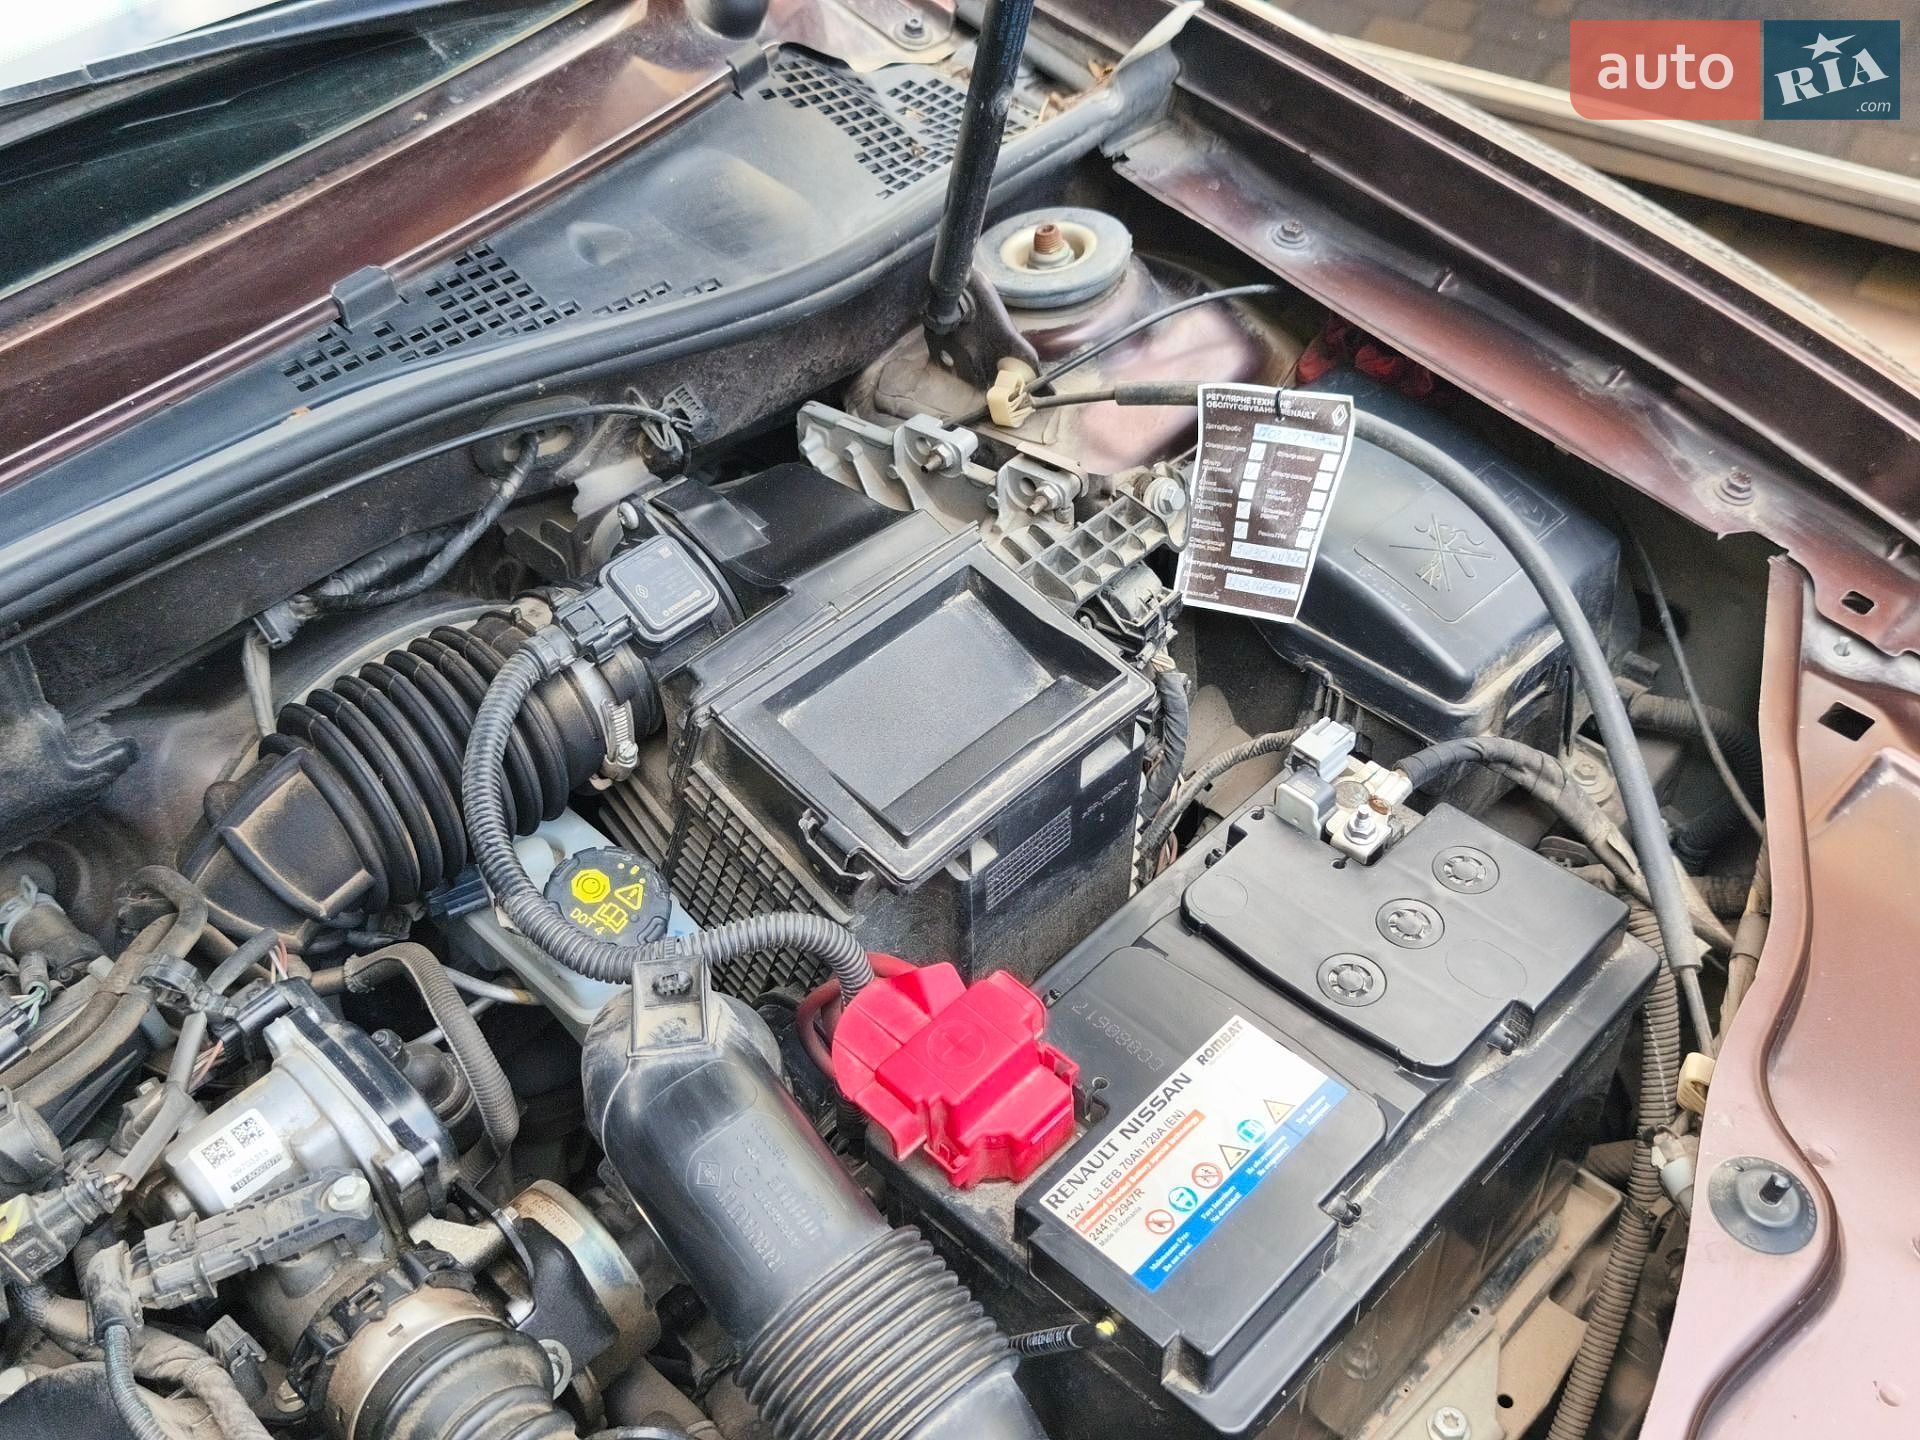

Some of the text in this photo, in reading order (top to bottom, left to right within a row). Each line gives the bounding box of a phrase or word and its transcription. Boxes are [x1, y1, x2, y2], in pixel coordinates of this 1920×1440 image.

[570, 907, 596, 928] DOT
[1045, 1069, 1193, 1211] RENAULT NISSAN
[1066, 1202, 1085, 1222] 12V
[1088, 1185, 1103, 1201] L3
[1100, 1168, 1122, 1189] EFB
[1119, 1145, 1145, 1171] 70Ah
[1141, 1124, 1167, 1149] 720A
[1163, 1107, 1186, 1130] (EN)
[1088, 1186, 1145, 1242] 24410 2947R
